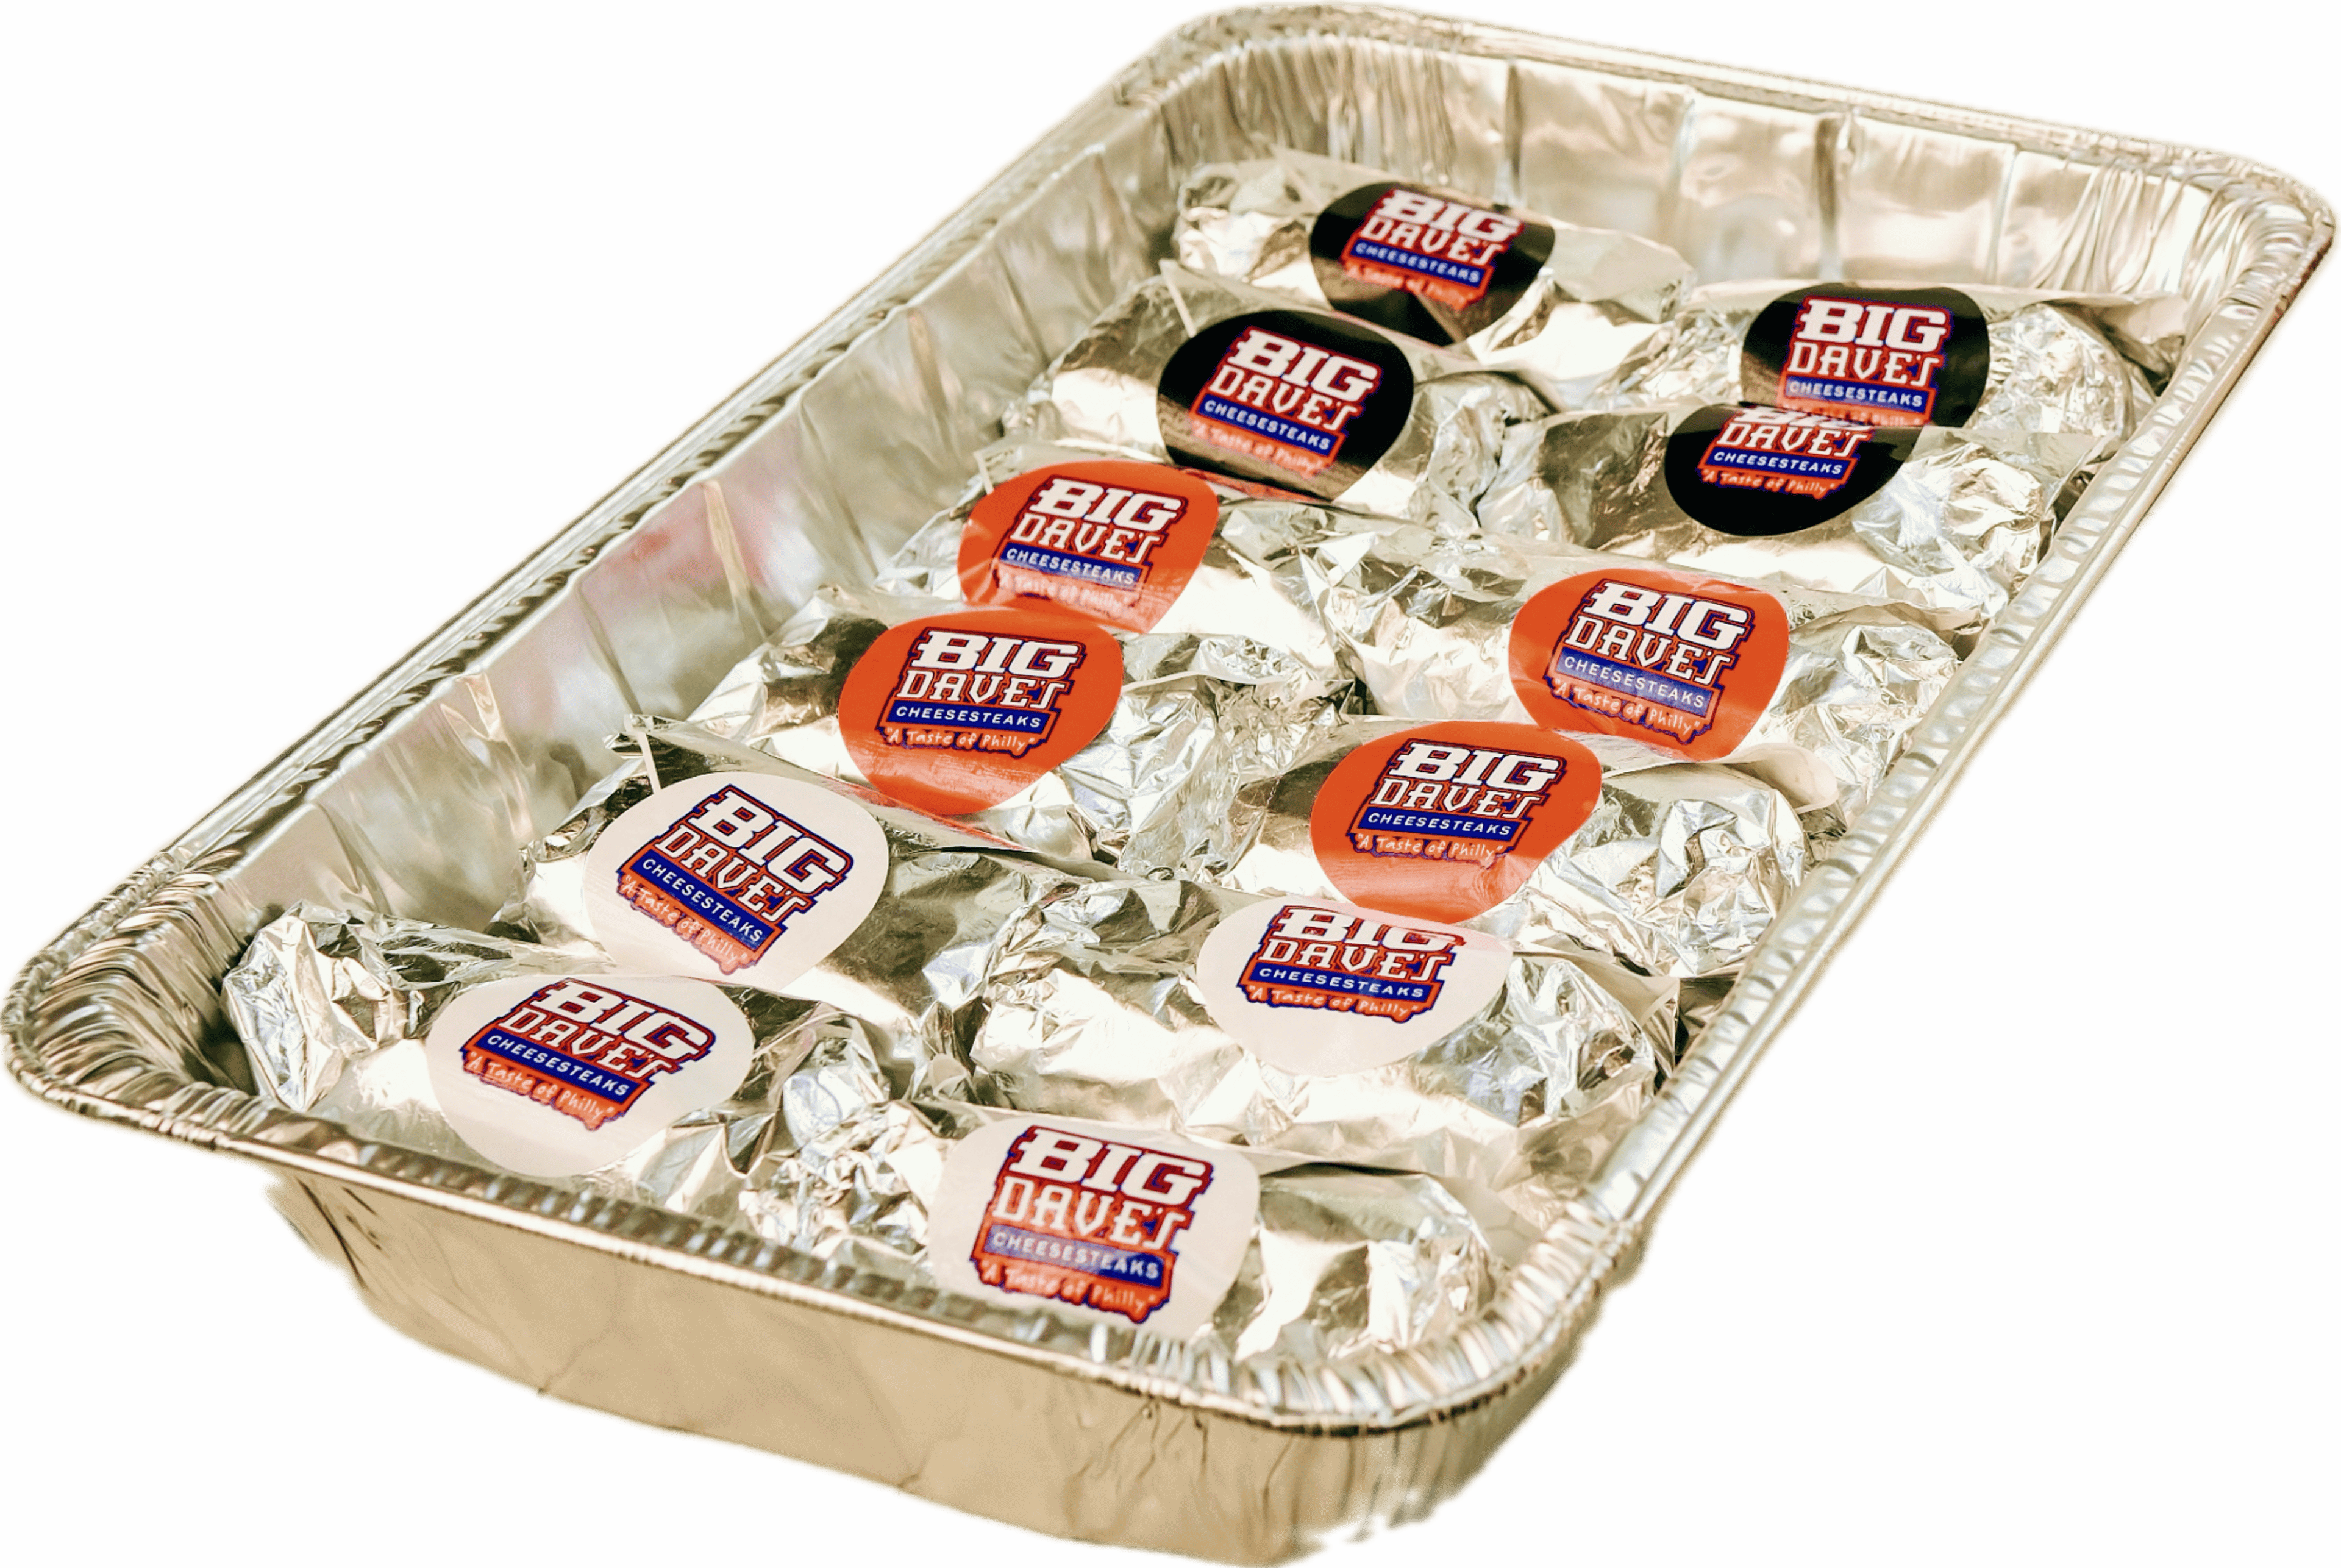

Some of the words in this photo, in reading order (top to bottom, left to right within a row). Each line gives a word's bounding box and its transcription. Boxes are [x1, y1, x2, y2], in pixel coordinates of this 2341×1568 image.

[1359, 216, 1503, 265] DAVE'S
[1375, 190, 1520, 242] BIG
[1355, 242, 1480, 283] CHEESESTEAKS
[1797, 299, 1947, 352] BIG
[1227, 329, 1378, 401] BIG
[1788, 341, 1939, 386] DAVE'S
[1208, 366, 1358, 431] DAVE'S
[1789, 380, 1923, 407] CHEESESTEAKS
[1204, 400, 1330, 449] CHEESESTEAKS
[1717, 422, 1868, 457] DAVE'S
[1714, 452, 1842, 474] CHEESESTEAKS
[1721, 472, 1762, 486] Taste
[1767, 478, 1784, 488] of
[1029, 479, 1181, 532] BIG
[1010, 513, 1160, 563] DAVE'S
[1006, 548, 1135, 585] CHEESESTEAKS
[1583, 582, 1747, 650] BIG
[911, 631, 1079, 678] BIG
[1564, 616, 1730, 685] DAVE'S
[896, 670, 1065, 709] DAVE'S
[1564, 656, 1705, 708] CHEESESTEAKS
[896, 706, 1041, 729] CHEESESTEAKS
[1573, 686, 1619, 711] Taste
[1626, 702, 1644, 719] of
[1649, 712, 1700, 735] Philly"
[907, 731, 951, 746] Taste
[959, 734, 977, 749] of
[982, 735, 1035, 752] Philly"
[1389, 743, 1559, 792] BIG
[1370, 778, 1540, 818] DAVE'S
[688, 790, 846, 893] BIG
[1368, 813, 1511, 835] CHEESESTEAKS
[655, 824, 808, 922] DAVE'S
[1377, 837, 1422, 853] Taste
[1428, 841, 1445, 855] of
[1451, 843, 1503, 861] Philly"
[643, 858, 764, 943] CHEESESTEAKS
[638, 887, 679, 921] Taste
[681, 921, 701, 935] of
[700, 928, 748, 964] Philly"
[1273, 908, 1459, 952] BIG
[1258, 940, 1453, 982] DAVE'S
[1260, 968, 1424, 998] CHEESESTEAKS
[531, 981, 711, 1061] BIG
[1272, 990, 1325, 1007] Taste
[1332, 997, 1353, 1010] of
[1359, 1000, 1420, 1017] Philly"
[488, 1036, 630, 1096] CHEESESTEAKS
[498, 1007, 673, 1080] DAVE'S
[487, 1061, 533, 1089] Taste
[536, 1084, 558, 1098] of
[560, 1090, 615, 1121] Philly"
[1008, 1128, 1206, 1205] BIG
[992, 1176, 1186, 1250] DAVE'S
[993, 1230, 1158, 1280] CHEESESTEAKS
